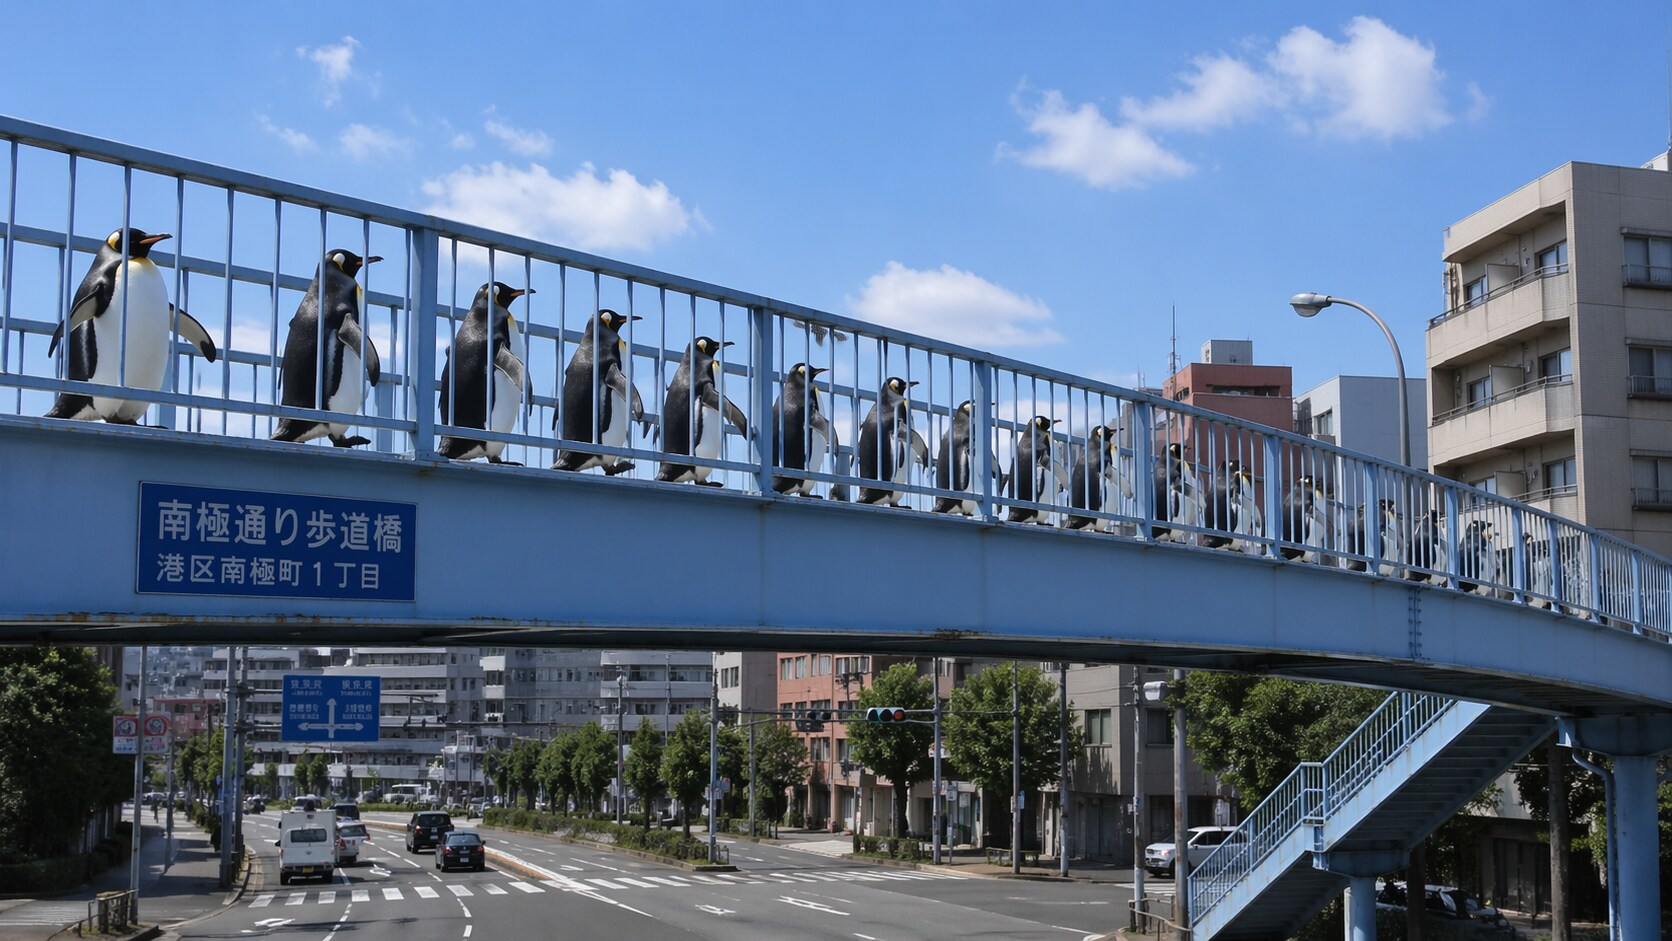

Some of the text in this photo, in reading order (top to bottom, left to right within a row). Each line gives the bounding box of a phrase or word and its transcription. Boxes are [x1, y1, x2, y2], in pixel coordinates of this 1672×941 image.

[157, 498, 403, 554] 南極通り歩道橋
[156, 552, 380, 590] 港区南極町1丁目
